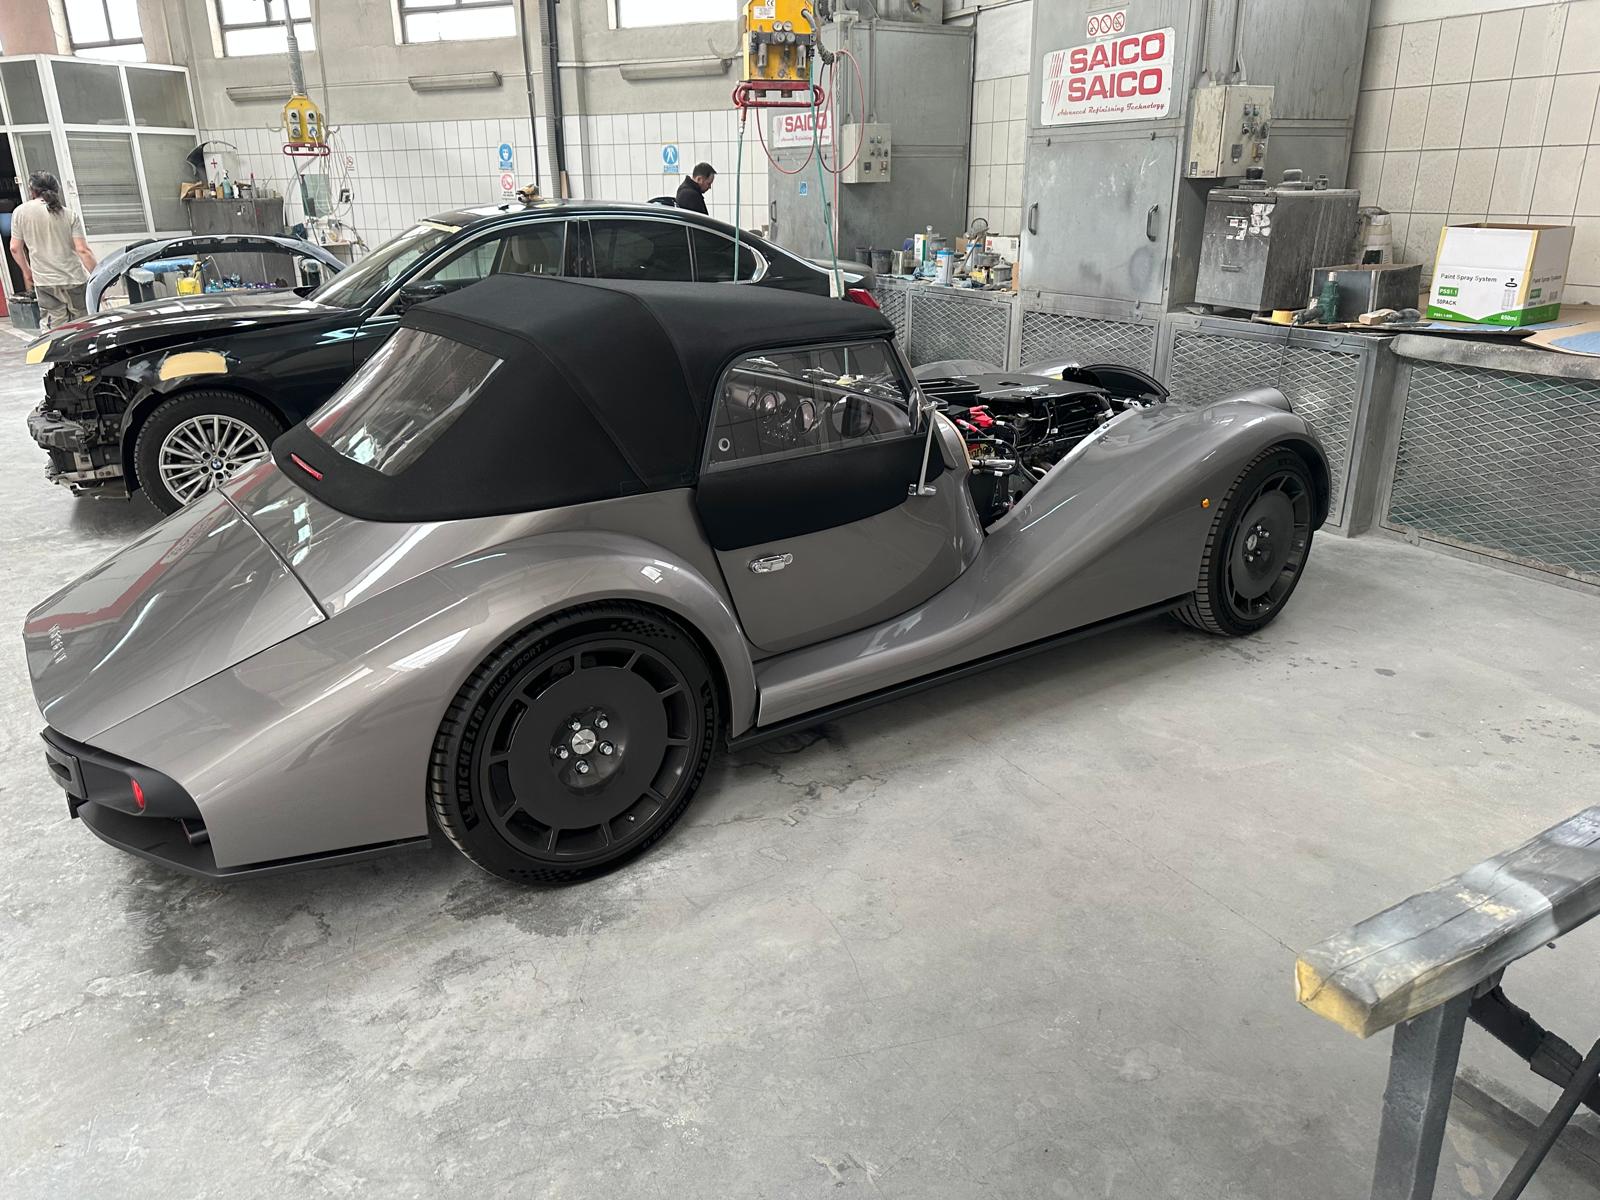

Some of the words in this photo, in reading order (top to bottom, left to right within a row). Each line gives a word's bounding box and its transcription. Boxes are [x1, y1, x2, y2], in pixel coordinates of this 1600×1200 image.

[1070, 33, 1165, 74] SAICO
[1068, 68, 1162, 102] SAICO
[1088, 105, 1125, 113] Refinishing
[1126, 102, 1165, 110] Technology
[1457, 274, 1473, 282] Spray
[458, 704, 487, 803] MICHELIN
[488, 670, 511, 698] PILOT
[512, 643, 543, 670] SPORT
[691, 707, 714, 791] MICHELIN
